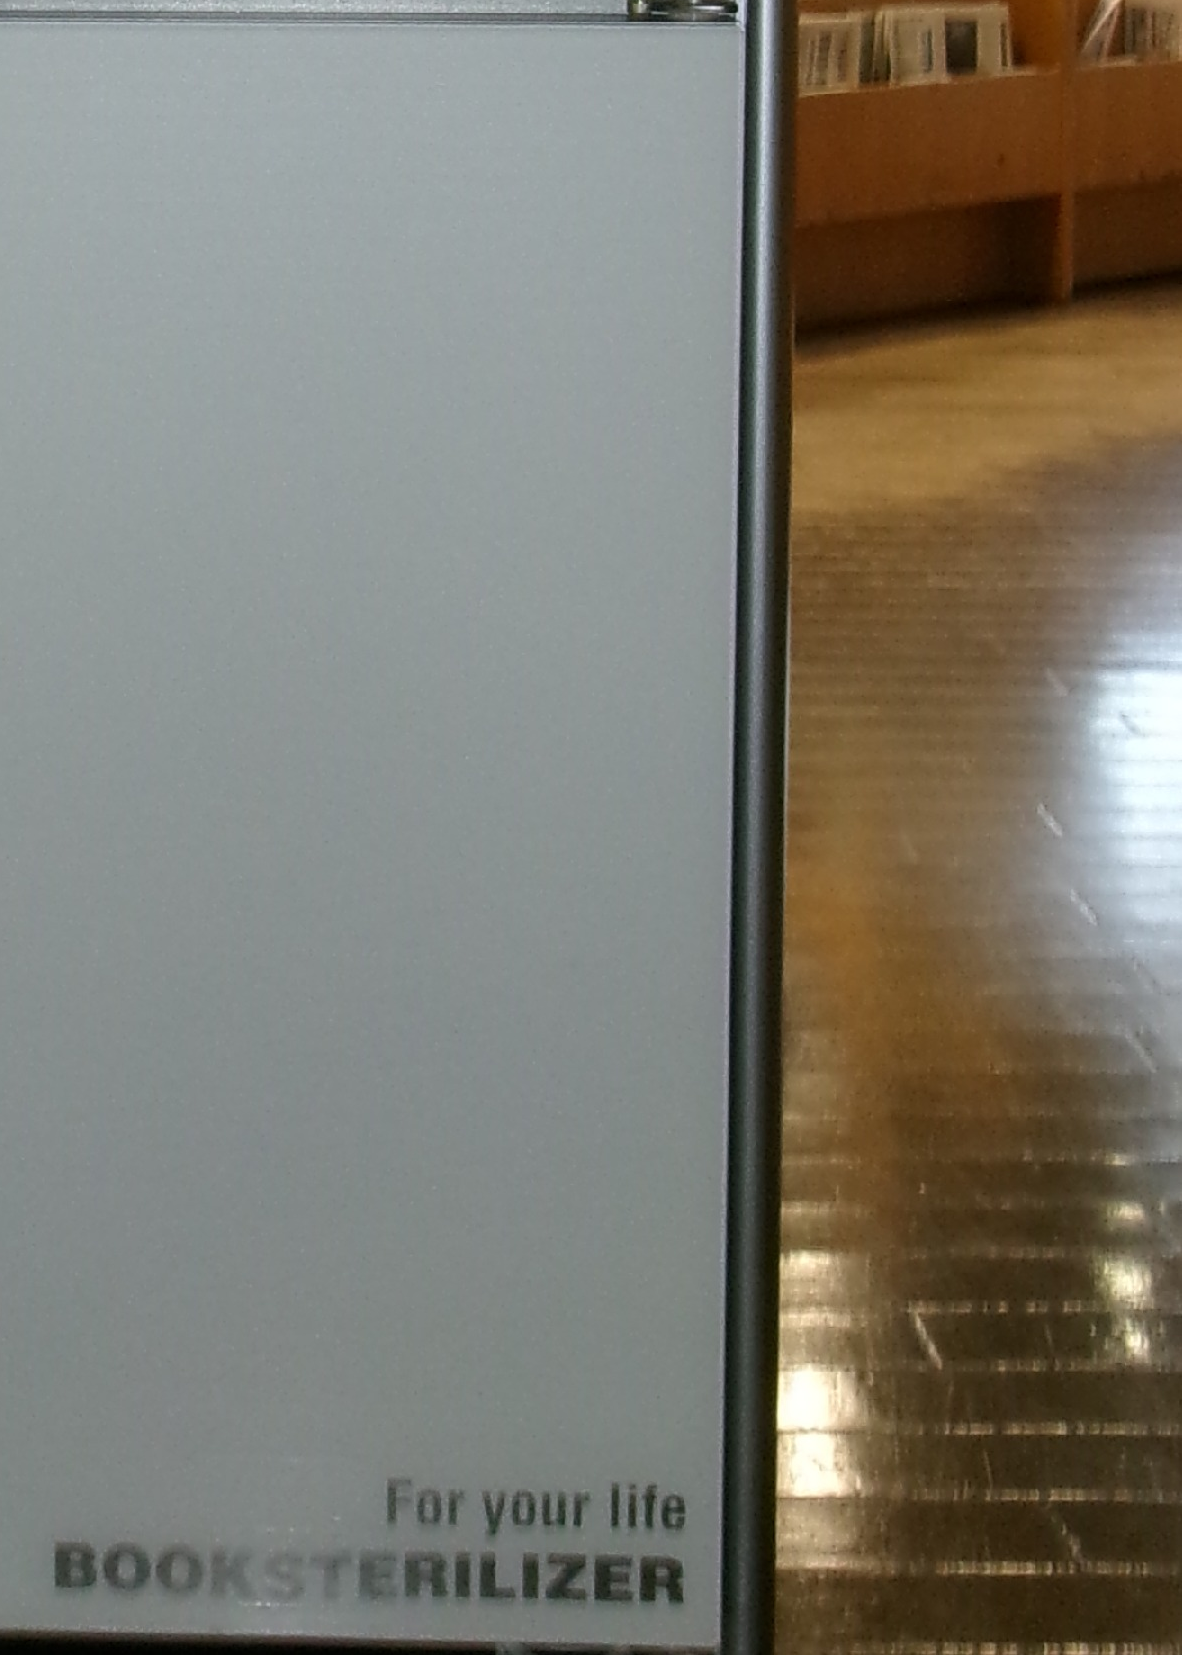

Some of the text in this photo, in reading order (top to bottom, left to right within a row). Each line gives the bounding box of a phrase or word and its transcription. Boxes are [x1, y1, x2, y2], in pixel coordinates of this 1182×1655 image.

[386, 1476, 687, 1536] For your life
[53, 1543, 686, 1602] BOOKSTERILIZER
